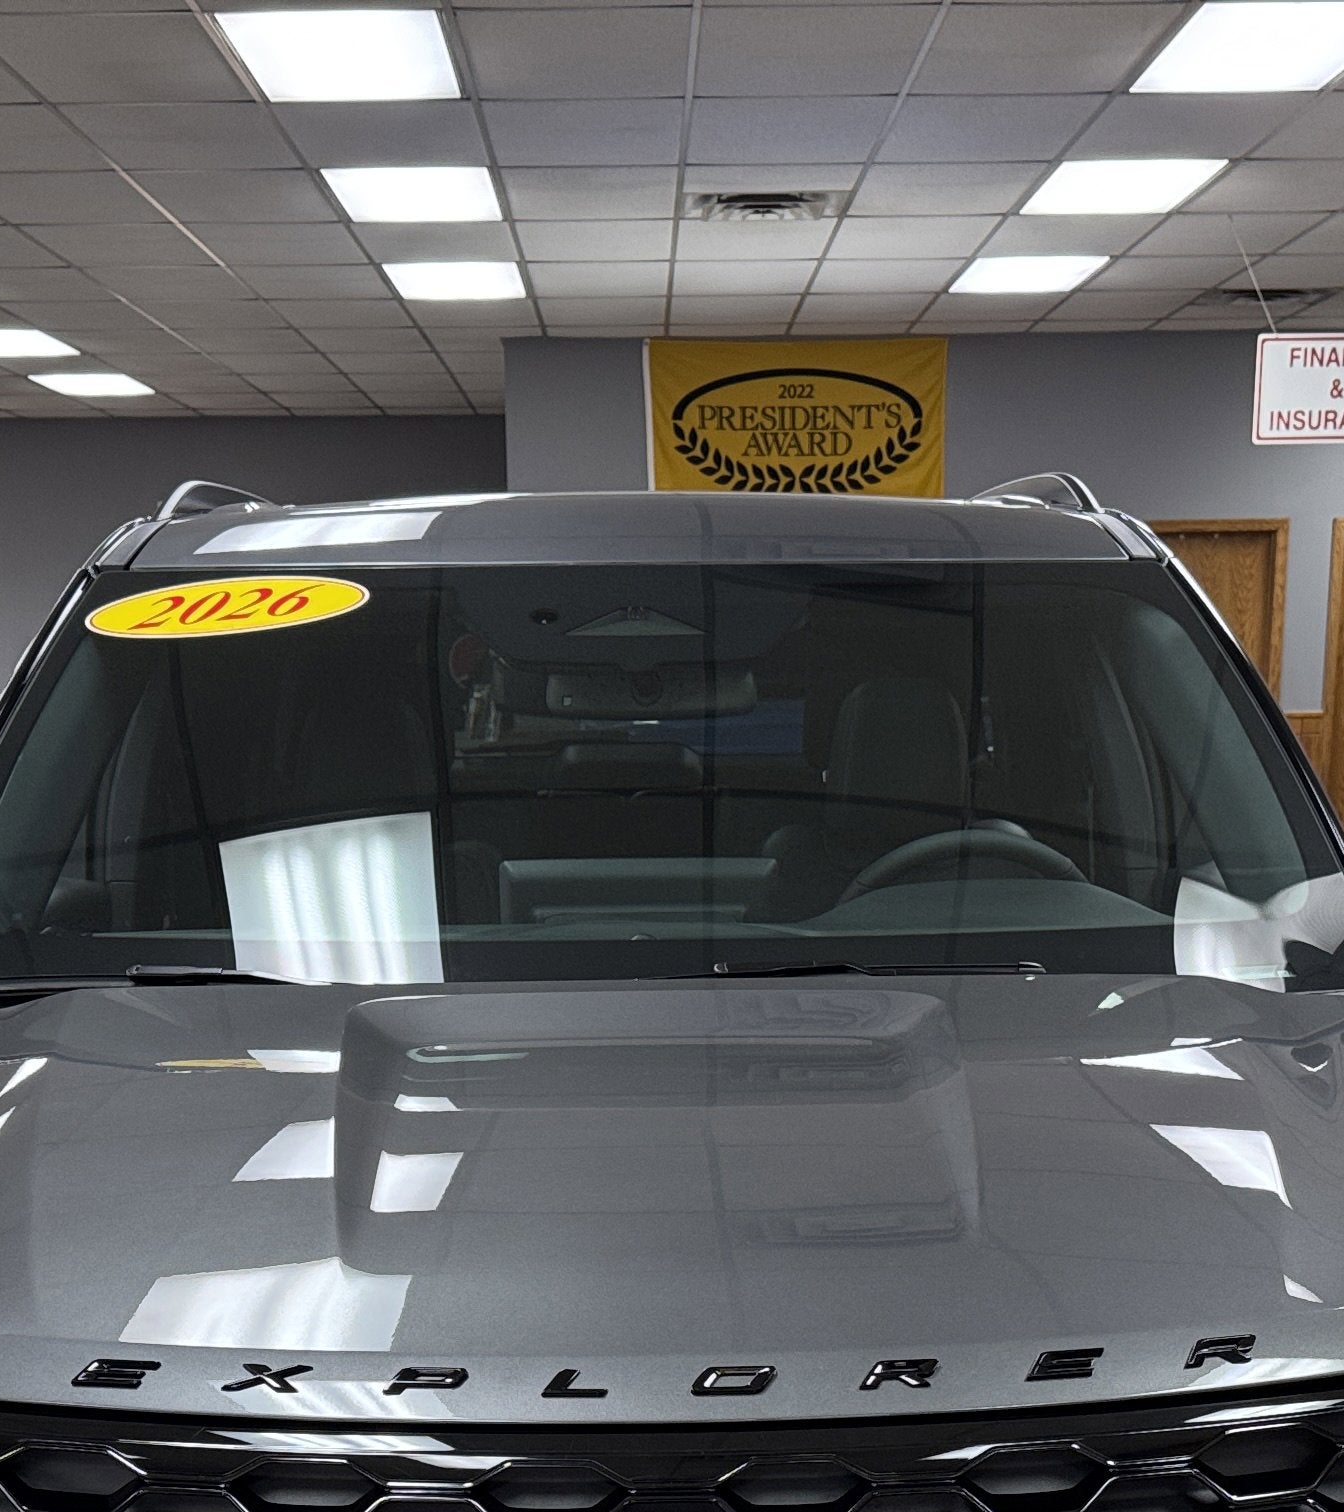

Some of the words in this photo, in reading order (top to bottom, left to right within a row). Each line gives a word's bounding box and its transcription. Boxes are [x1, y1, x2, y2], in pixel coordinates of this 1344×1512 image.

[778, 383, 814, 399] 2022
[1329, 378, 1344, 399] &
[697, 402, 902, 431] PRESIDENT'S
[741, 431, 854, 457] AWARD
[126, 584, 326, 631] 2026
[71, 1334, 1256, 1398] EXPLORER
